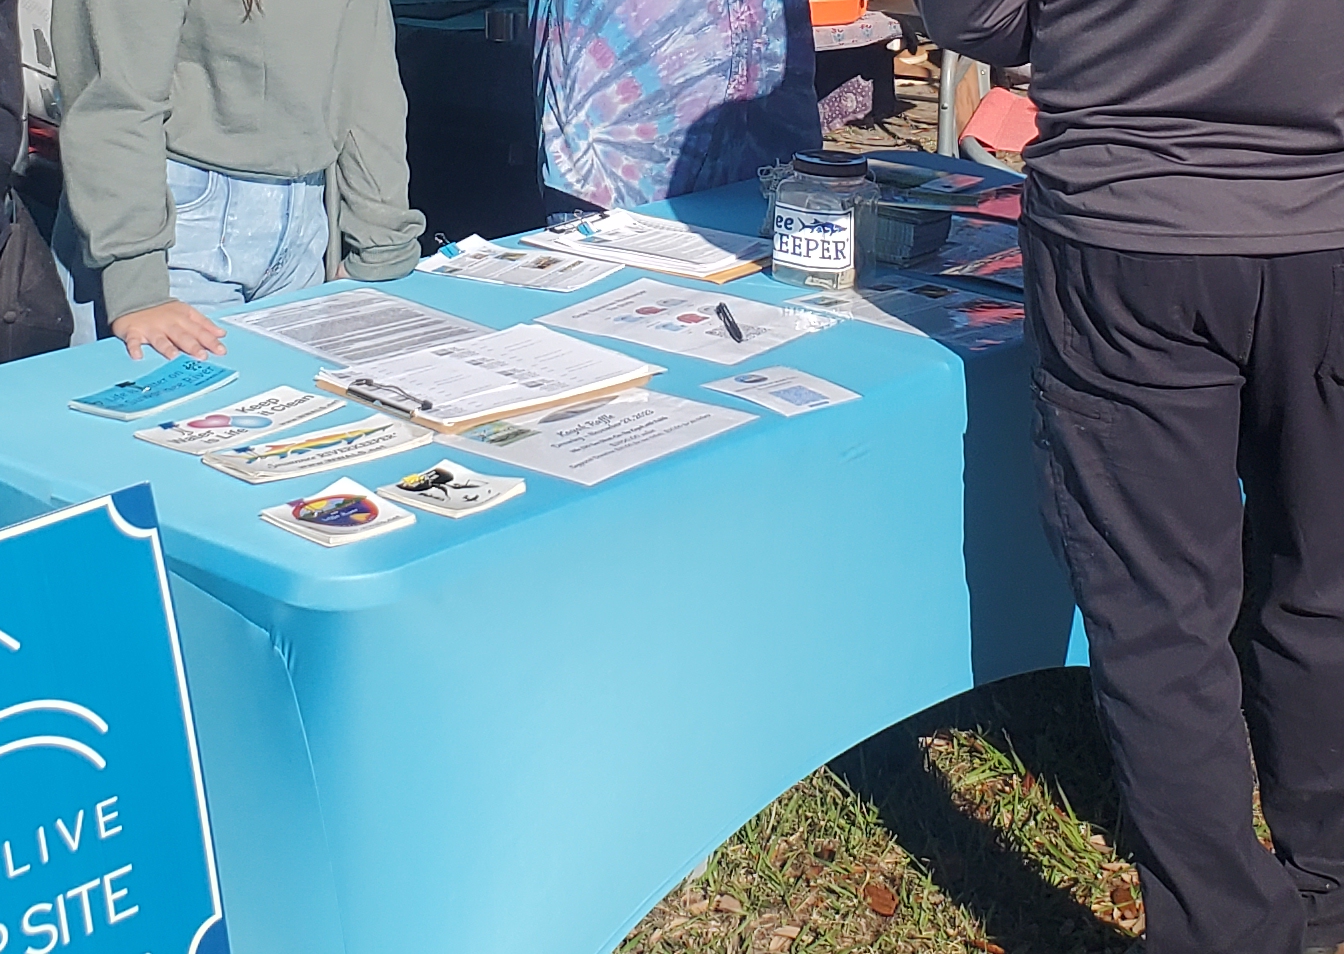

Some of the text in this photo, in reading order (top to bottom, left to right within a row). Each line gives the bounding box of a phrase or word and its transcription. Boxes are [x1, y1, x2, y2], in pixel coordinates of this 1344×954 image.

[185, 365, 216, 385] River
[235, 396, 280, 414] Keep
[257, 394, 315, 417] it Clean
[167, 429, 215, 445] Water
[200, 427, 249, 444] is Life
[20, 863, 140, 954] SITE
